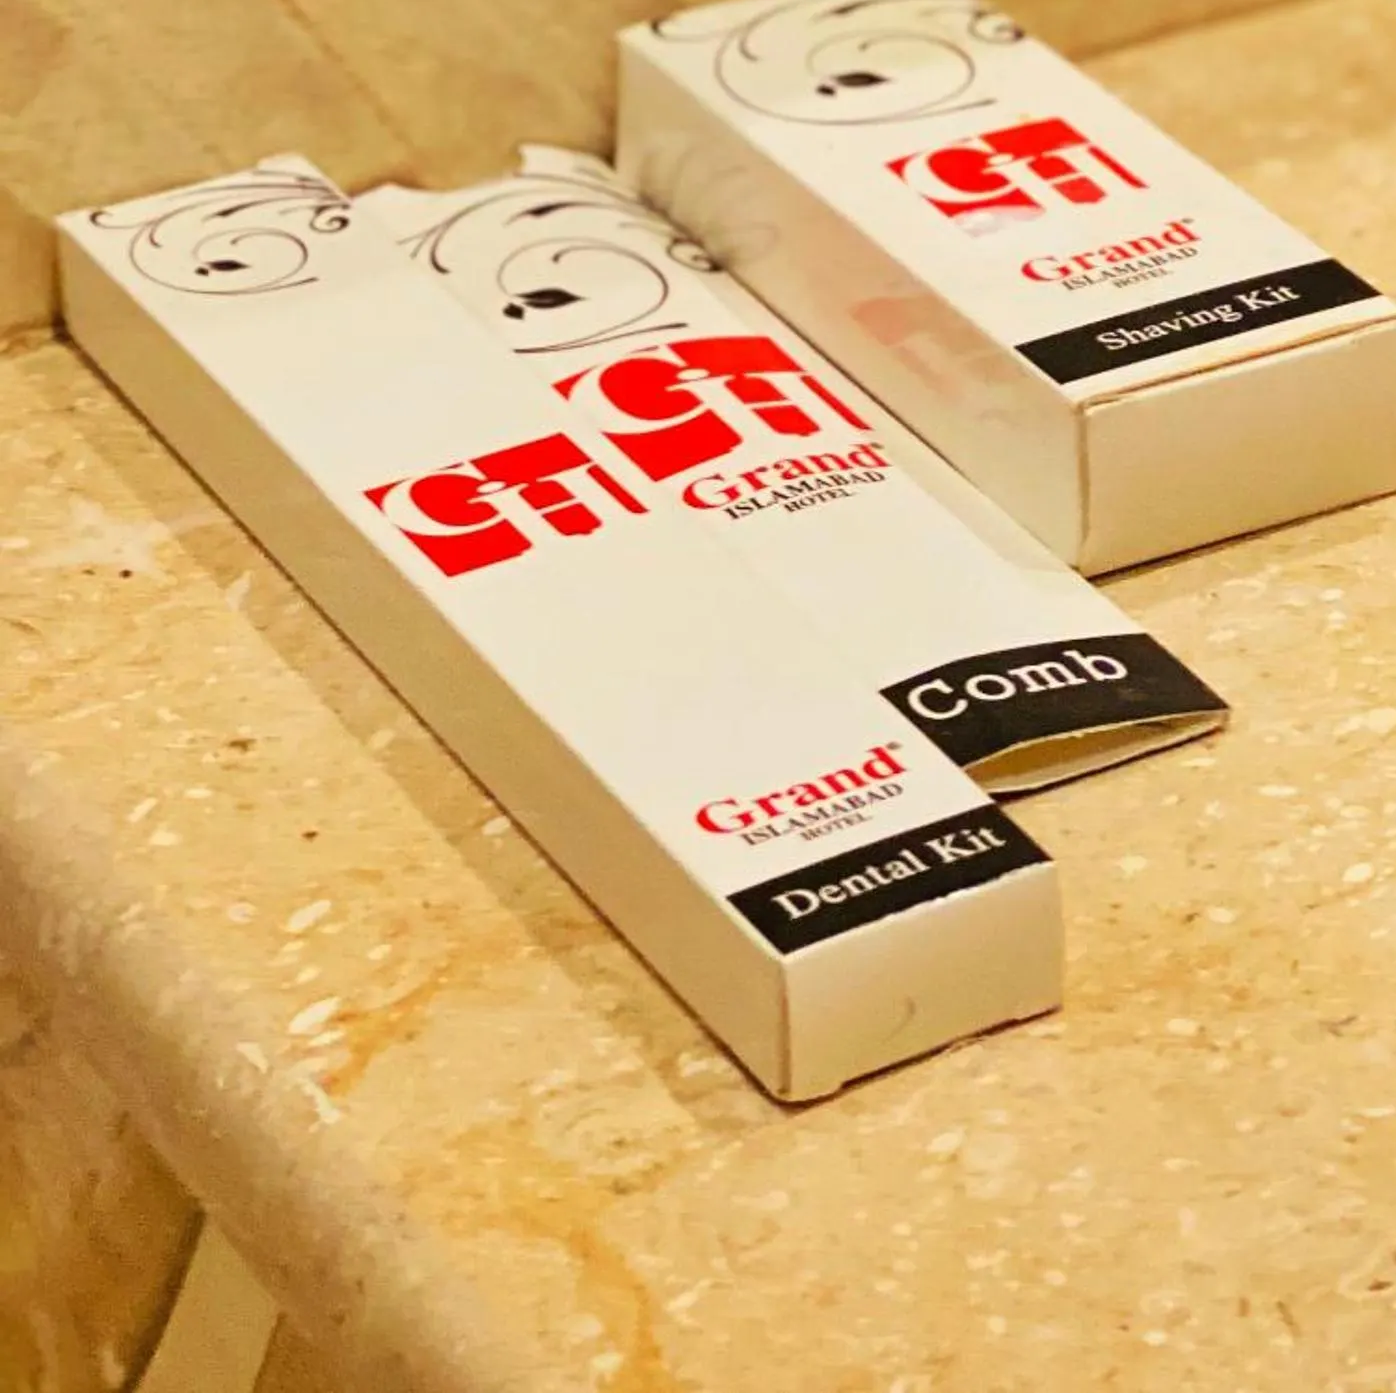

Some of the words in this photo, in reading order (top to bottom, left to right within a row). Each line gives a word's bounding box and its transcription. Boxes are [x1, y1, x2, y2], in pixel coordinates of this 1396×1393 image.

[1020, 221, 1201, 283] Grand
[1063, 246, 1199, 291] ISLAMABAD
[1097, 300, 1243, 351] Shaving
[1236, 283, 1300, 316] Kit
[680, 444, 889, 511] Grand
[723, 470, 886, 521] ISLAMABAD
[783, 490, 854, 512] HOTEL
[908, 650, 1127, 721] Comb
[696, 747, 907, 834] Grand
[742, 784, 904, 847] ISLAMABAD
[799, 814, 873, 842] HOTEL
[773, 855, 927, 921] Dental
[928, 828, 1006, 866] Kit
